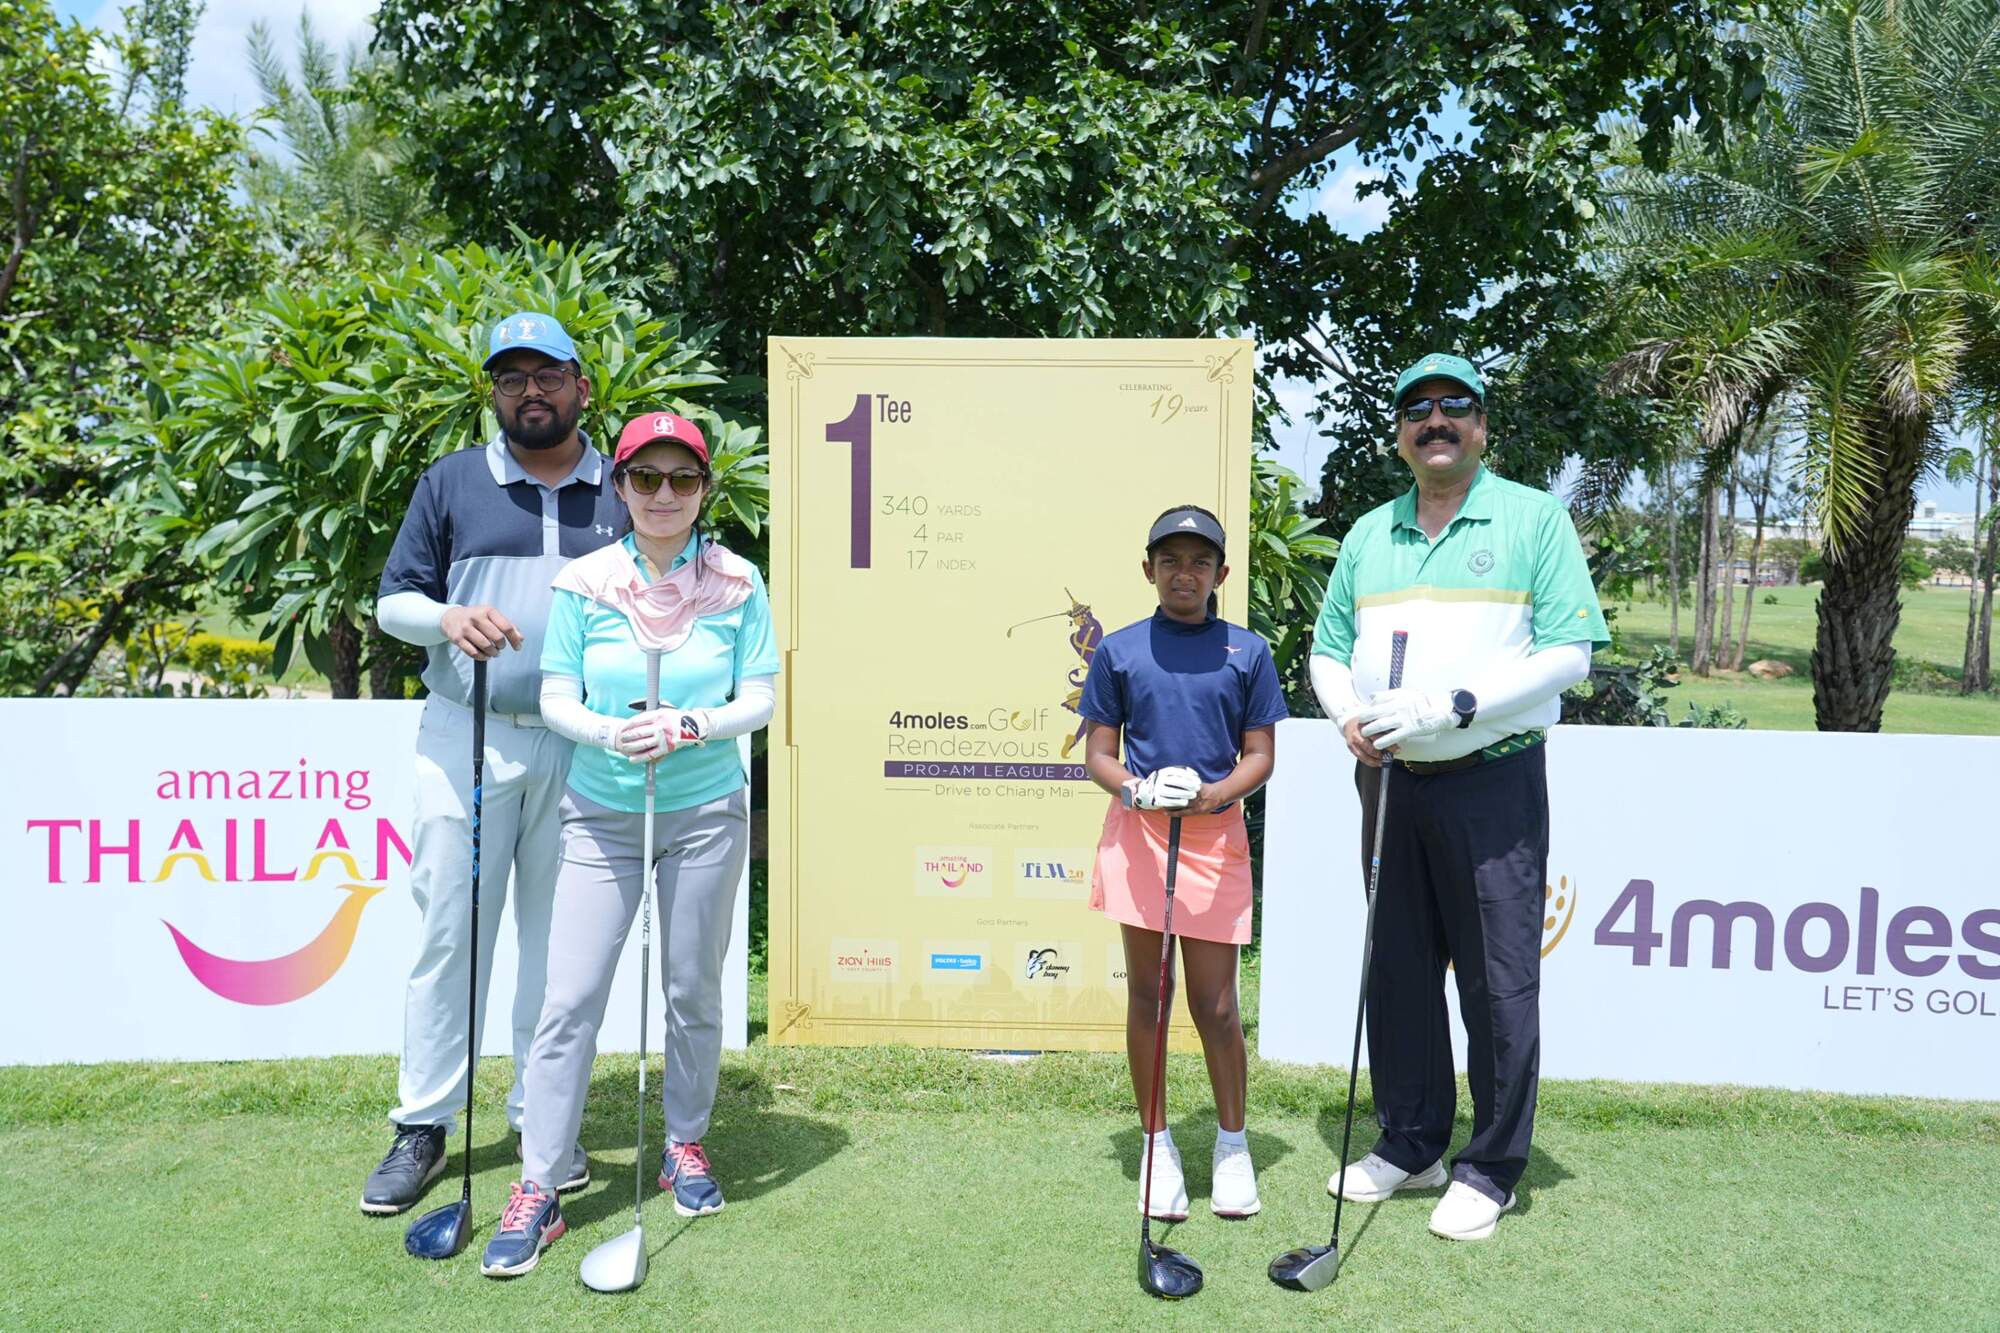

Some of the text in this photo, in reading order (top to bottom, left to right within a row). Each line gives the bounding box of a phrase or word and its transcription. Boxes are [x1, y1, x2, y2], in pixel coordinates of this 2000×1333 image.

[1119, 383, 1172, 391] CELEBRATING
[1150, 394, 1208, 424] 19 years
[826, 394, 911, 568] 1 Tee
[881, 495, 982, 516] 340 YARDS
[913, 524, 964, 543] 4 PAR
[907, 550, 976, 570] 17 INDEX
[988, 708, 1048, 731] Golf
[888, 734, 1049, 758] Rendezvous
[904, 764, 1090, 779] PRO-AM LEAGUE 20
[156, 758, 371, 810] amazing
[935, 785, 1074, 799] Drive to Chiang Mai
[26, 817, 412, 883] THAILAN
[924, 862, 983, 873] THAILAND
[1594, 879, 2000, 980] 4moles
[837, 956, 863, 966] ZION
[1112, 971, 1127, 979] GO
[1823, 985, 2000, 1017] LET'S GOL
